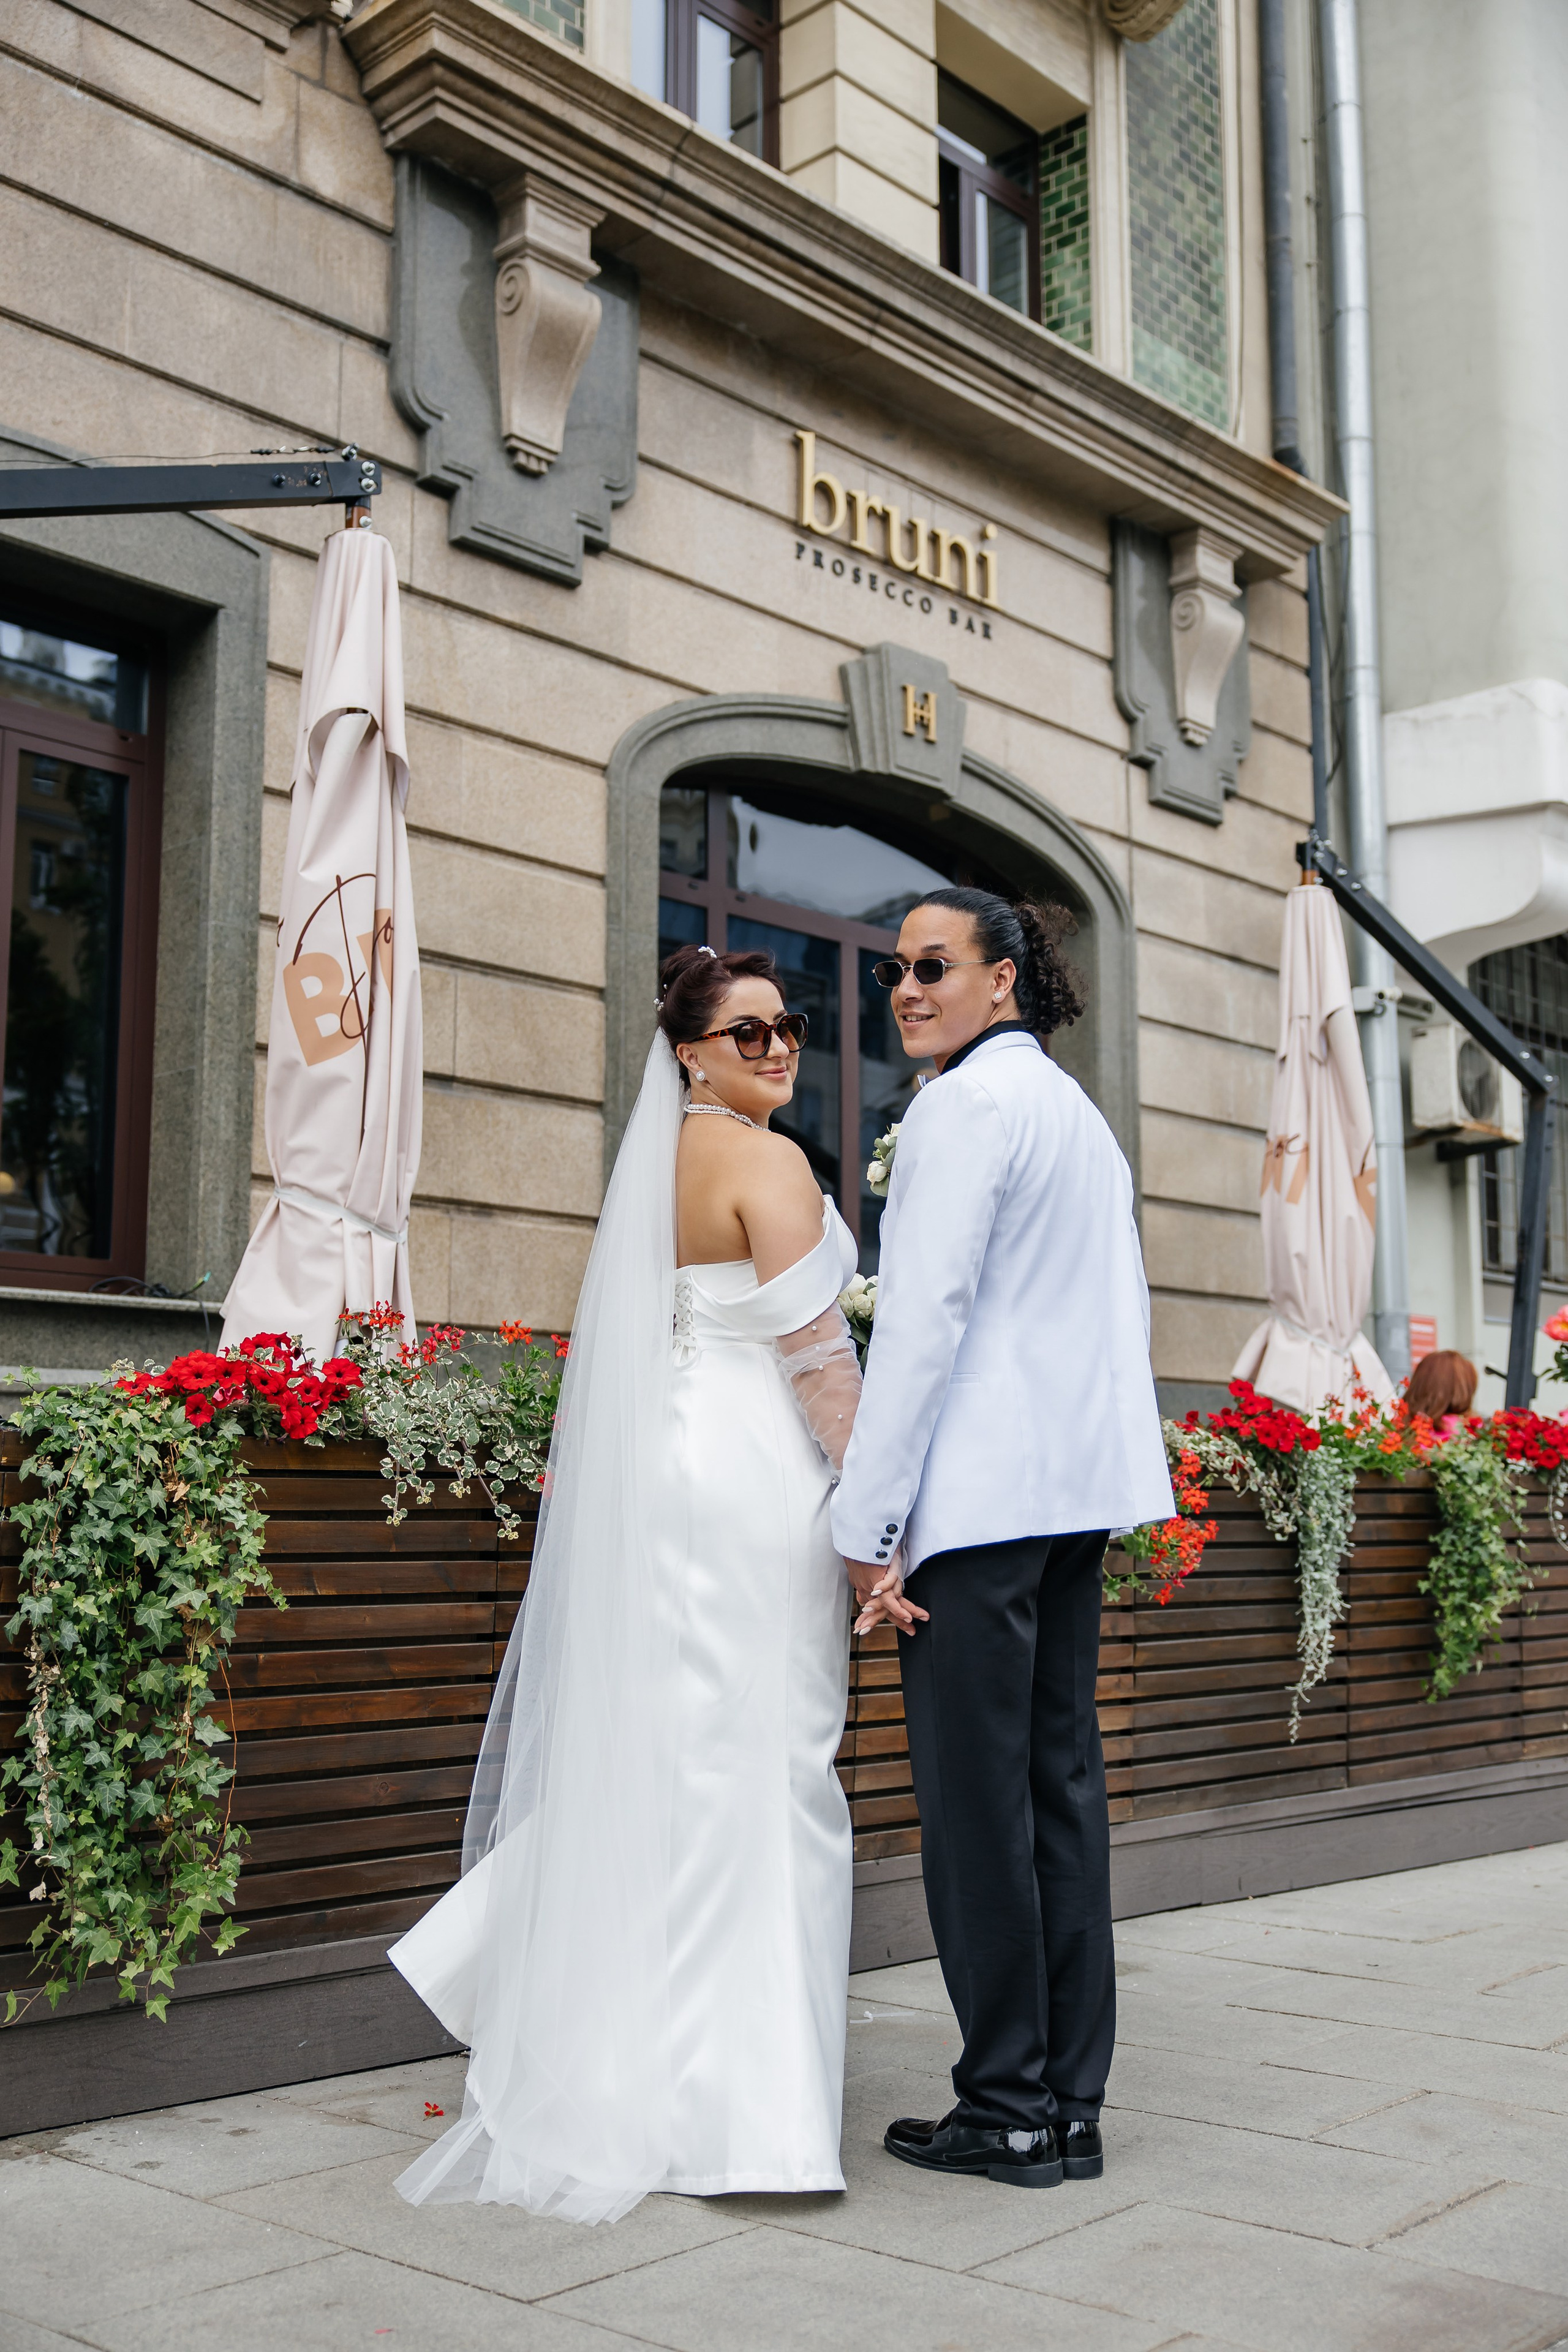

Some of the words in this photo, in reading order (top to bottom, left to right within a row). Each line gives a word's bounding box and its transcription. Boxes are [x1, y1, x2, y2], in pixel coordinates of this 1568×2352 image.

[796, 430, 999, 610] bruni
[795, 541, 932, 613] PROSECCO
[948, 607, 992, 639] BAR
